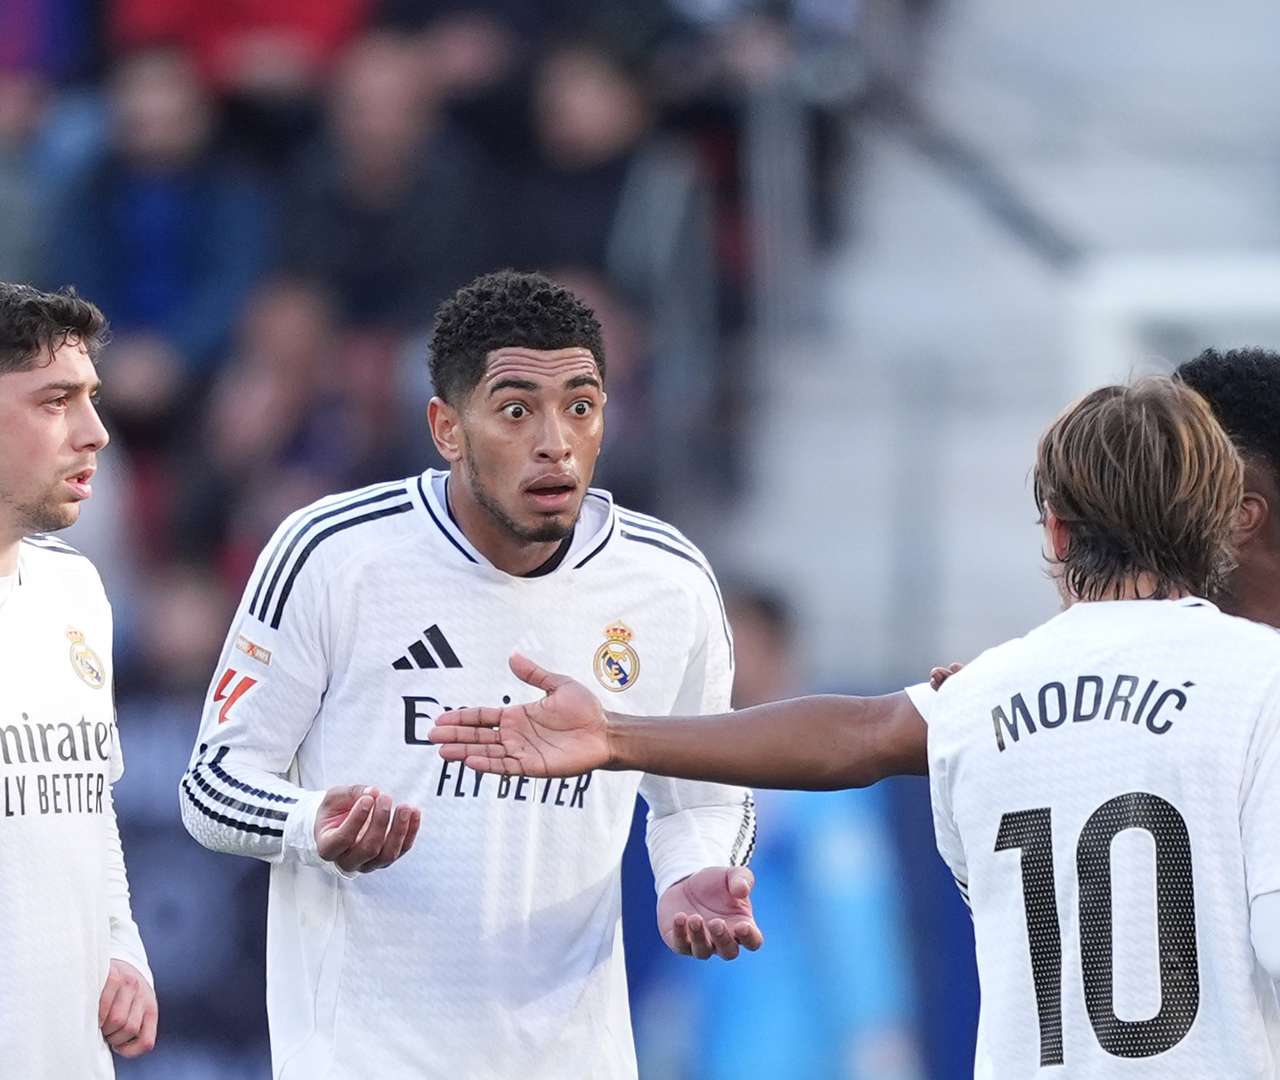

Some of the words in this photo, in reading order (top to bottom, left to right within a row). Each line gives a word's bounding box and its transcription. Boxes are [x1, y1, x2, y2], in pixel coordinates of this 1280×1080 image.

[991, 675, 1195, 752] MODRIĆ
[37, 772, 105, 815] BETTER
[994, 791, 1202, 1068] 10
